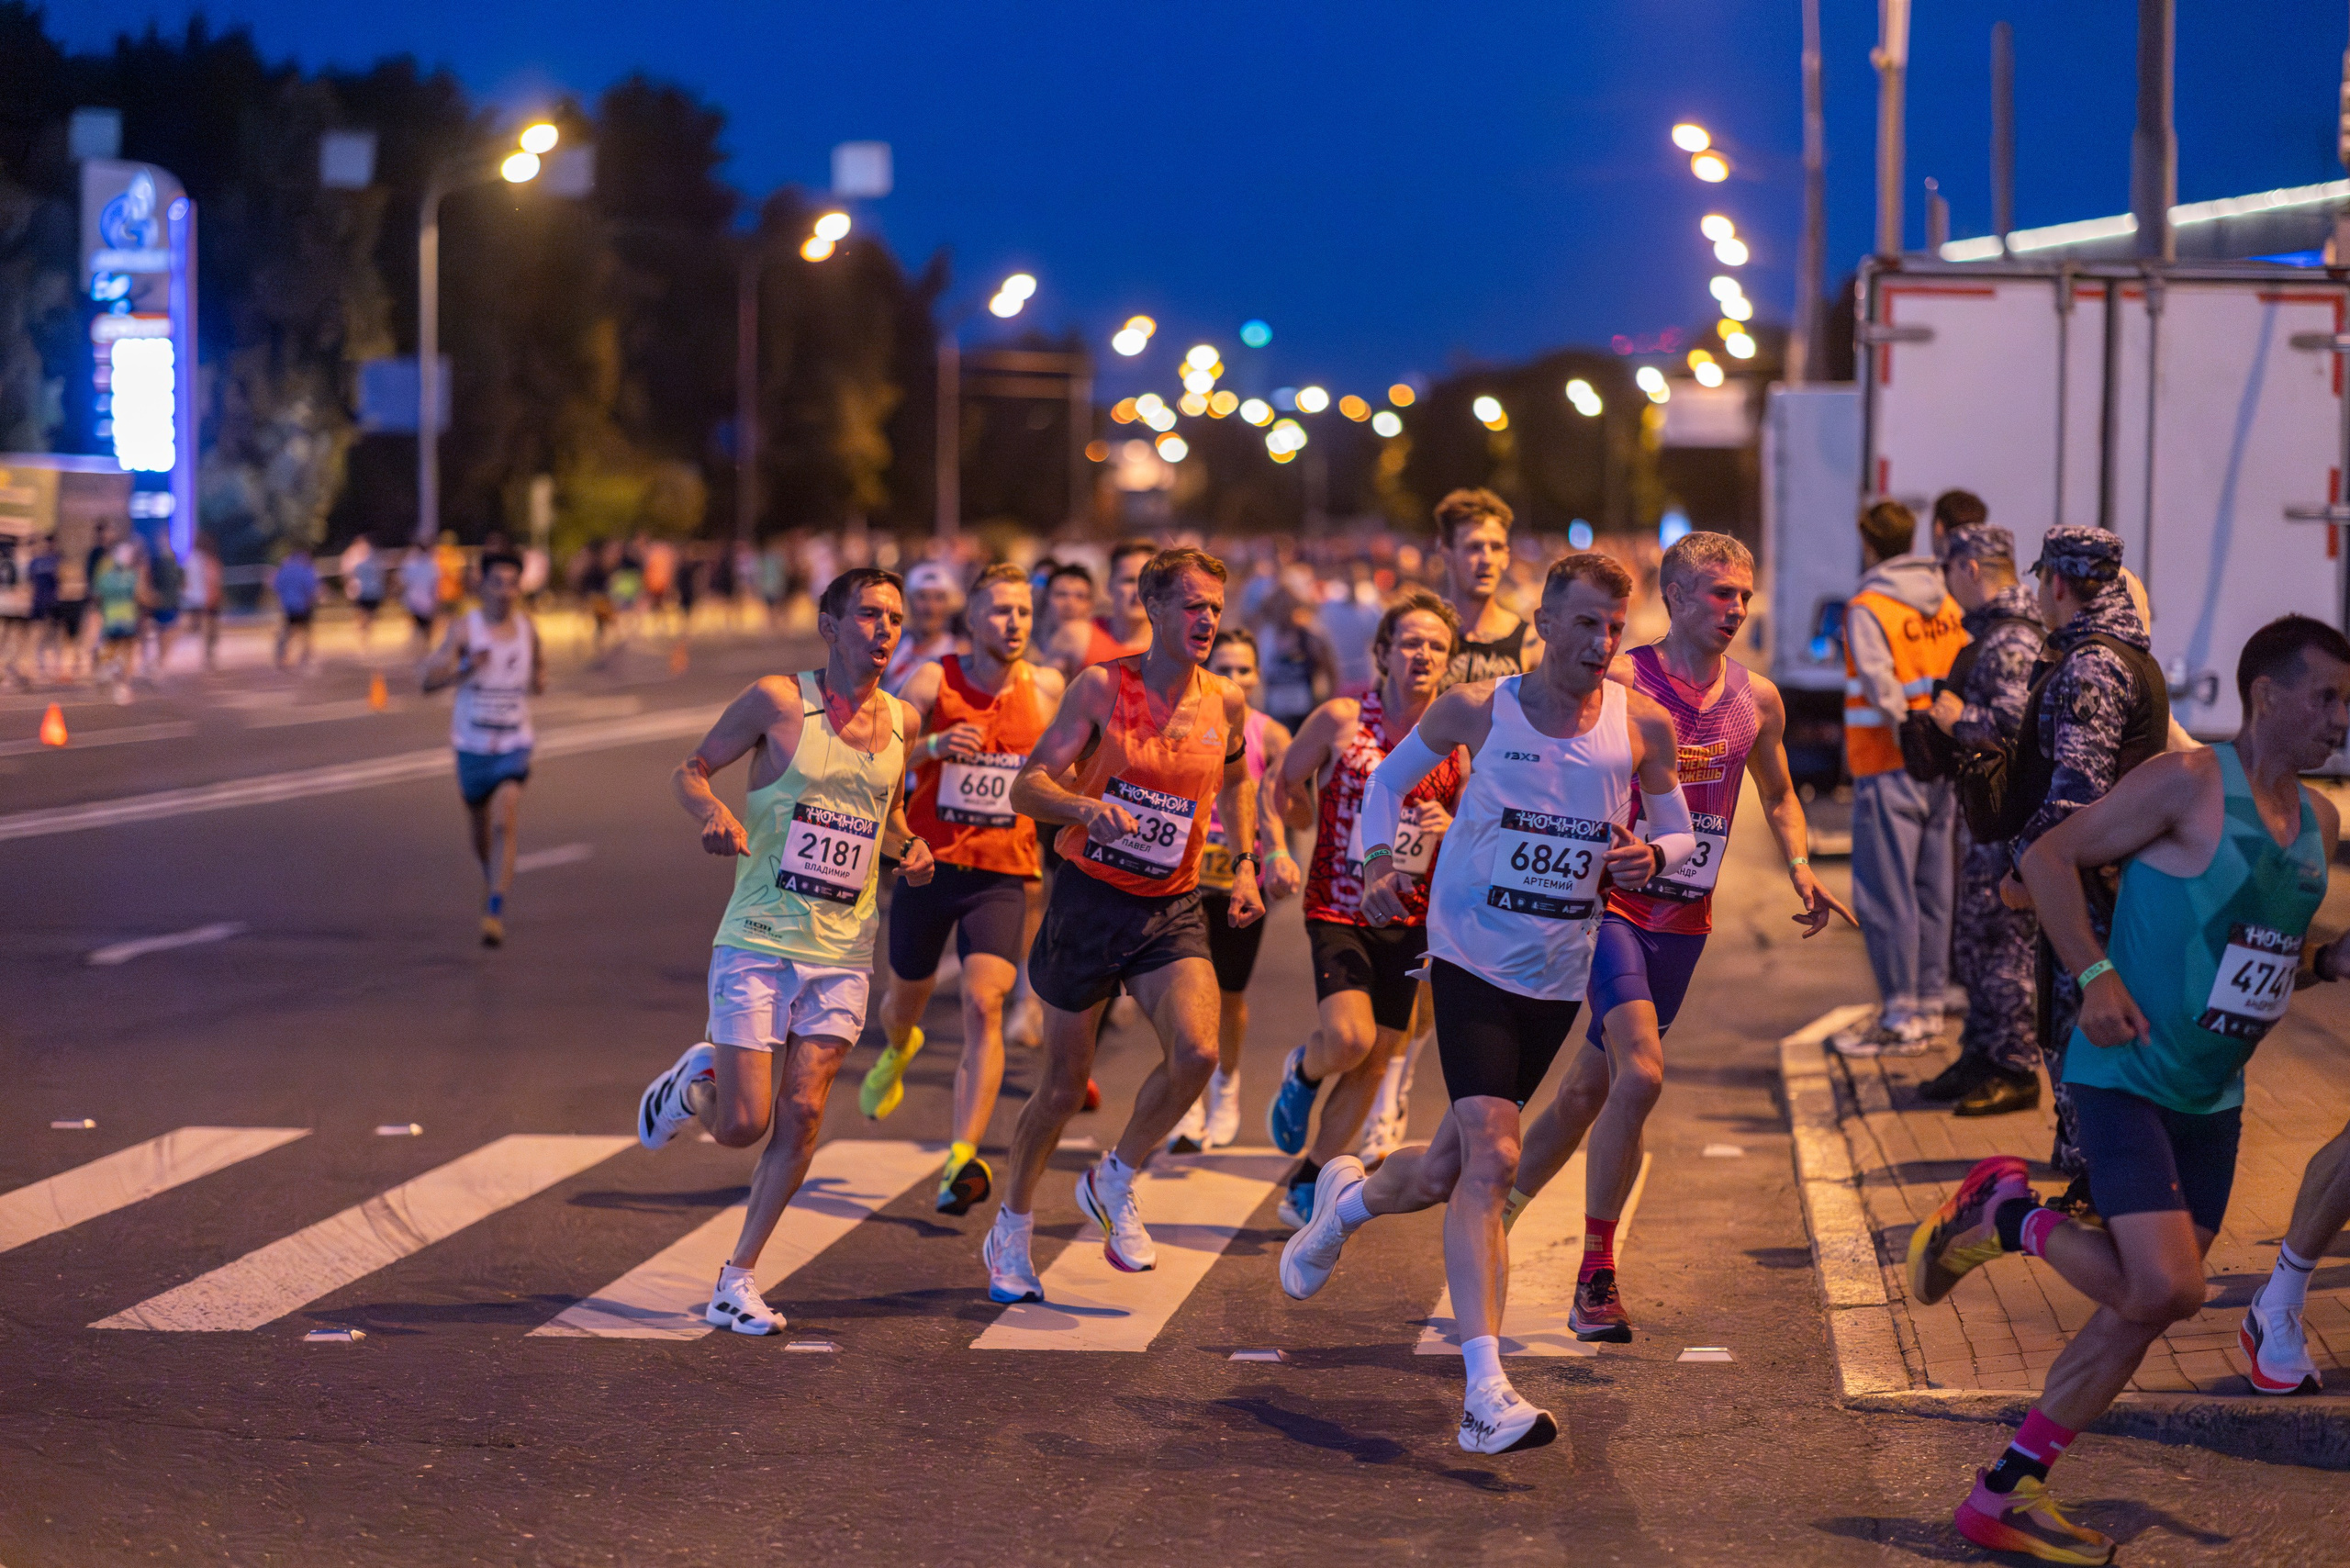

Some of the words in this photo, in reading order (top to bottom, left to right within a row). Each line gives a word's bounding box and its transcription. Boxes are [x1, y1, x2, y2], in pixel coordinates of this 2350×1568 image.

[960, 774, 1004, 798] 660
[1678, 768, 1722, 783] ОЖЕШЬ
[1119, 782, 1188, 812] НОЧНОЙ
[806, 807, 873, 834] НОЧНОЙ
[1516, 810, 1603, 836] НОЧНОЙ
[1691, 813, 1723, 831] НОЙ
[798, 833, 861, 870] 2181
[1122, 838, 1152, 853] ПАВЕЛ
[804, 862, 850, 879] ВЛАДИМИР
[1511, 842, 1593, 879] 6843
[1523, 876, 1573, 890] АРТЕМИЙ
